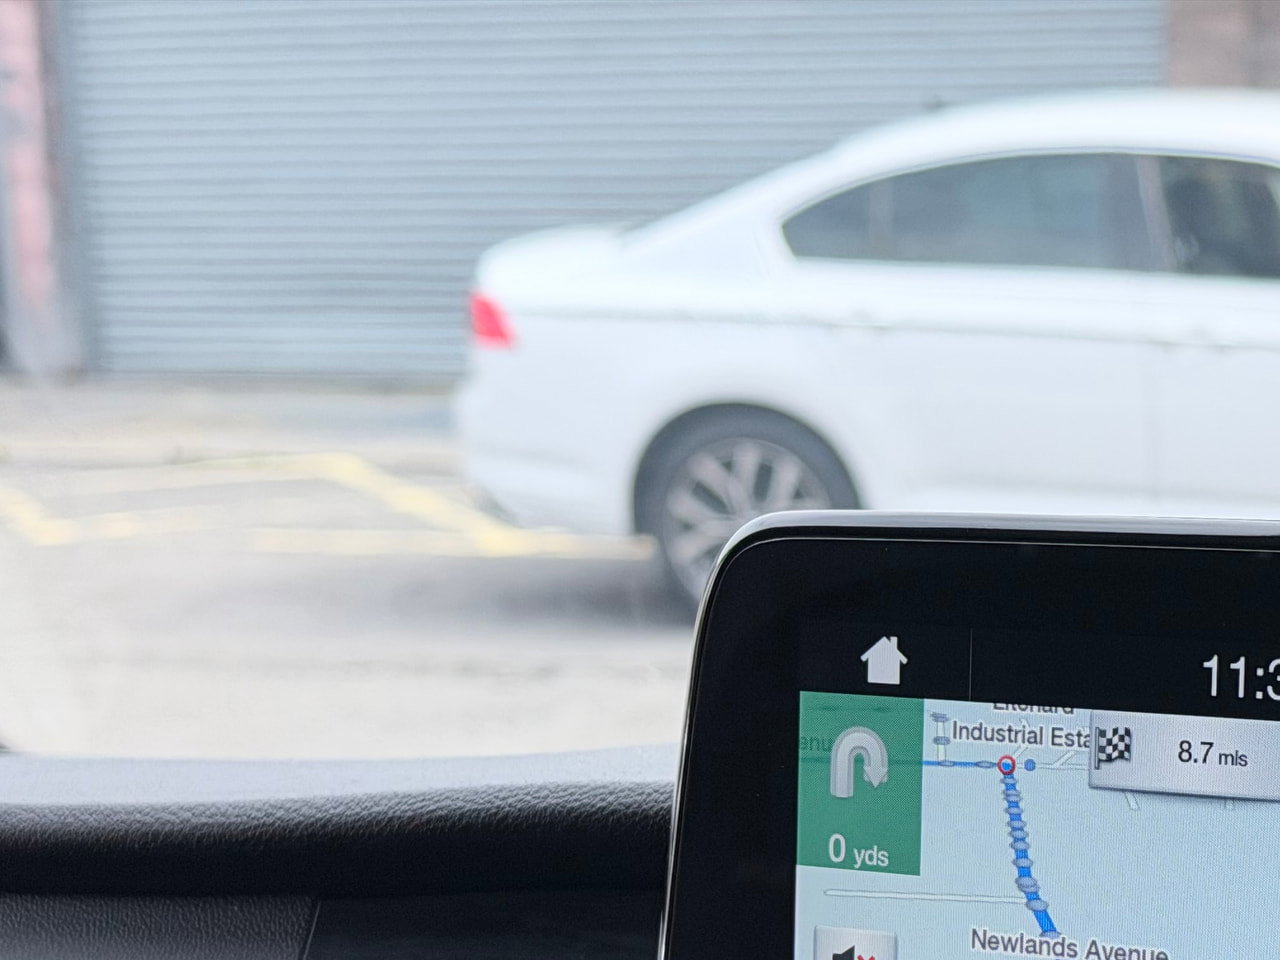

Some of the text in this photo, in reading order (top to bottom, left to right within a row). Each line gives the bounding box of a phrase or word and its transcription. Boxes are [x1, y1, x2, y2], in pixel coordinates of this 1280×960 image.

[952, 719, 1044, 746] Industrial
[1178, 740, 1214, 764] 8.7
[829, 833, 890, 869] 0 yds
[970, 928, 1079, 960] Newlands
